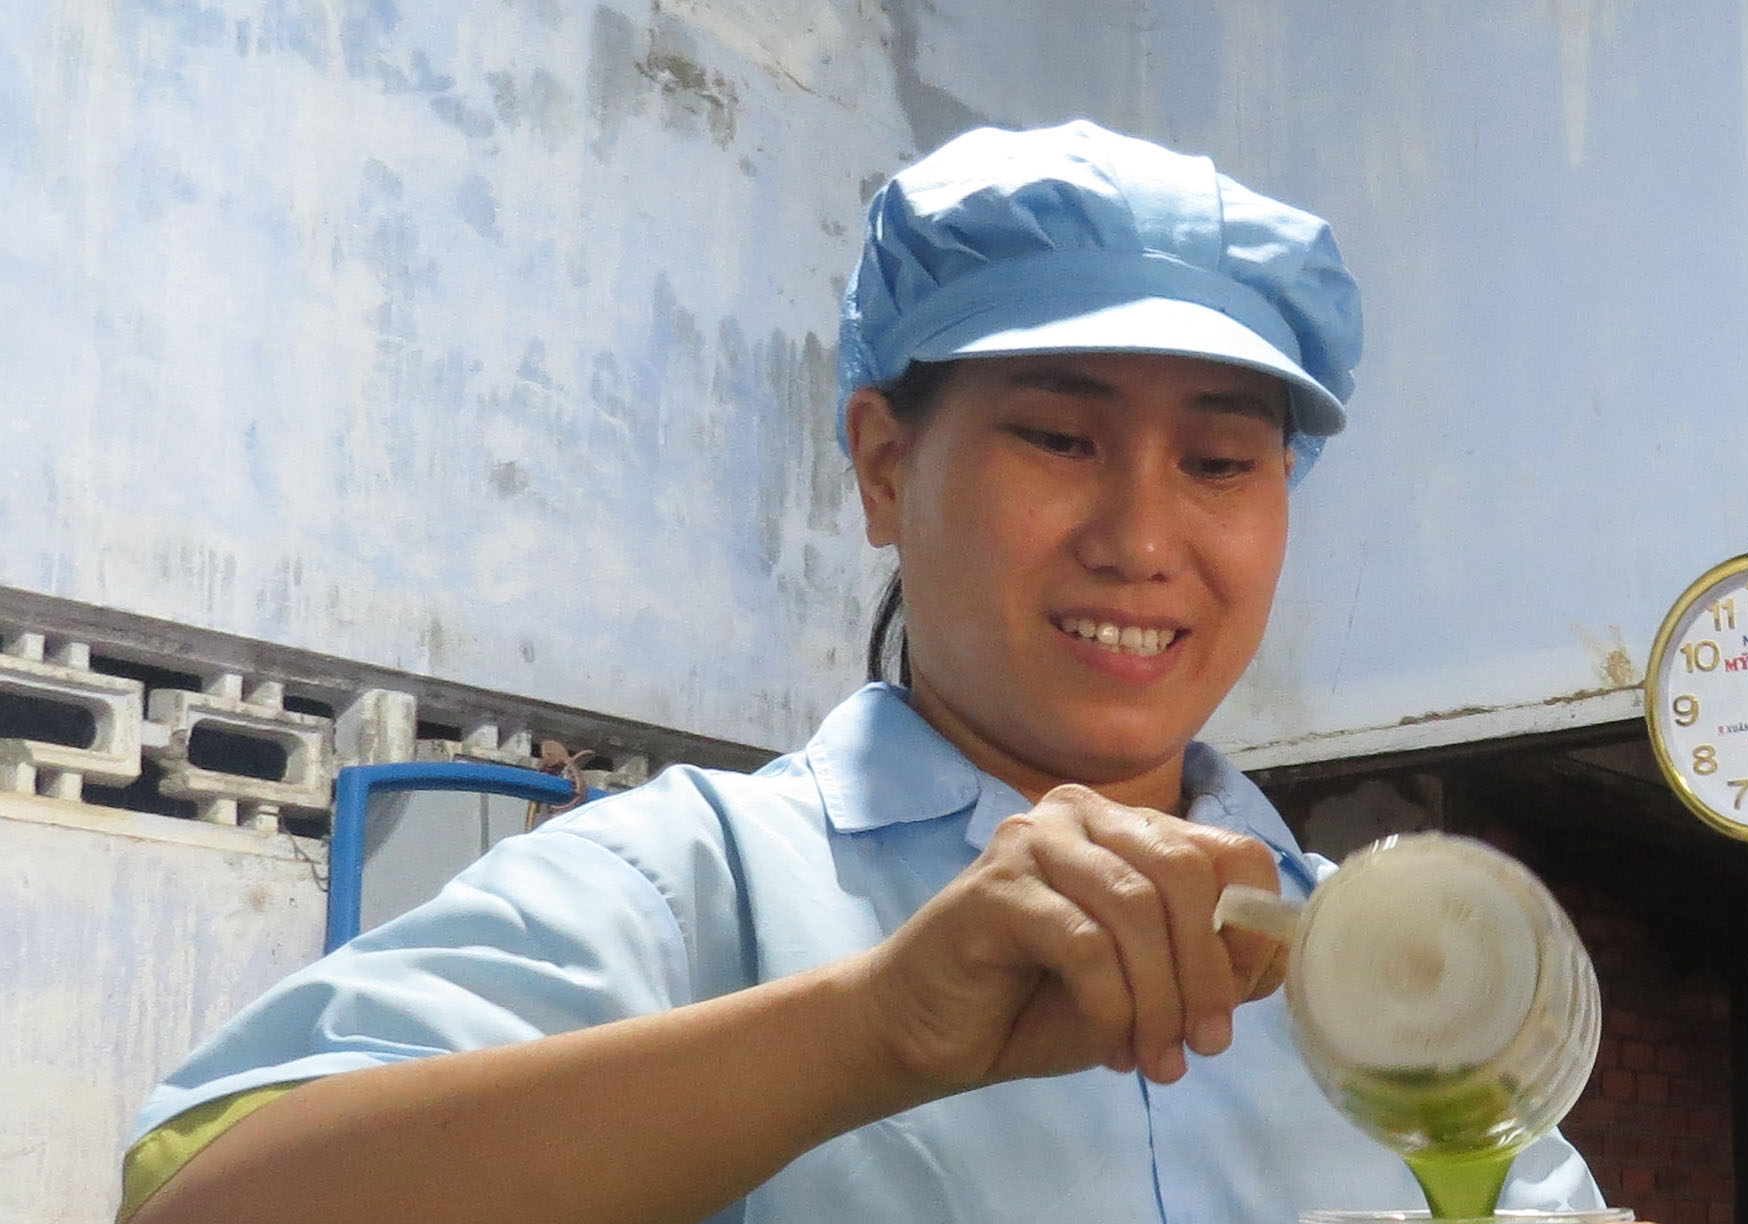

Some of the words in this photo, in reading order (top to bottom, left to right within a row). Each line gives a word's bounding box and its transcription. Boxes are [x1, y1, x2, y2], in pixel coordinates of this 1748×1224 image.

[1708, 599, 1736, 632] 11
[1680, 640, 1720, 673] 10
[1673, 695, 1699, 727] 9
[1692, 745, 1718, 776] 8
